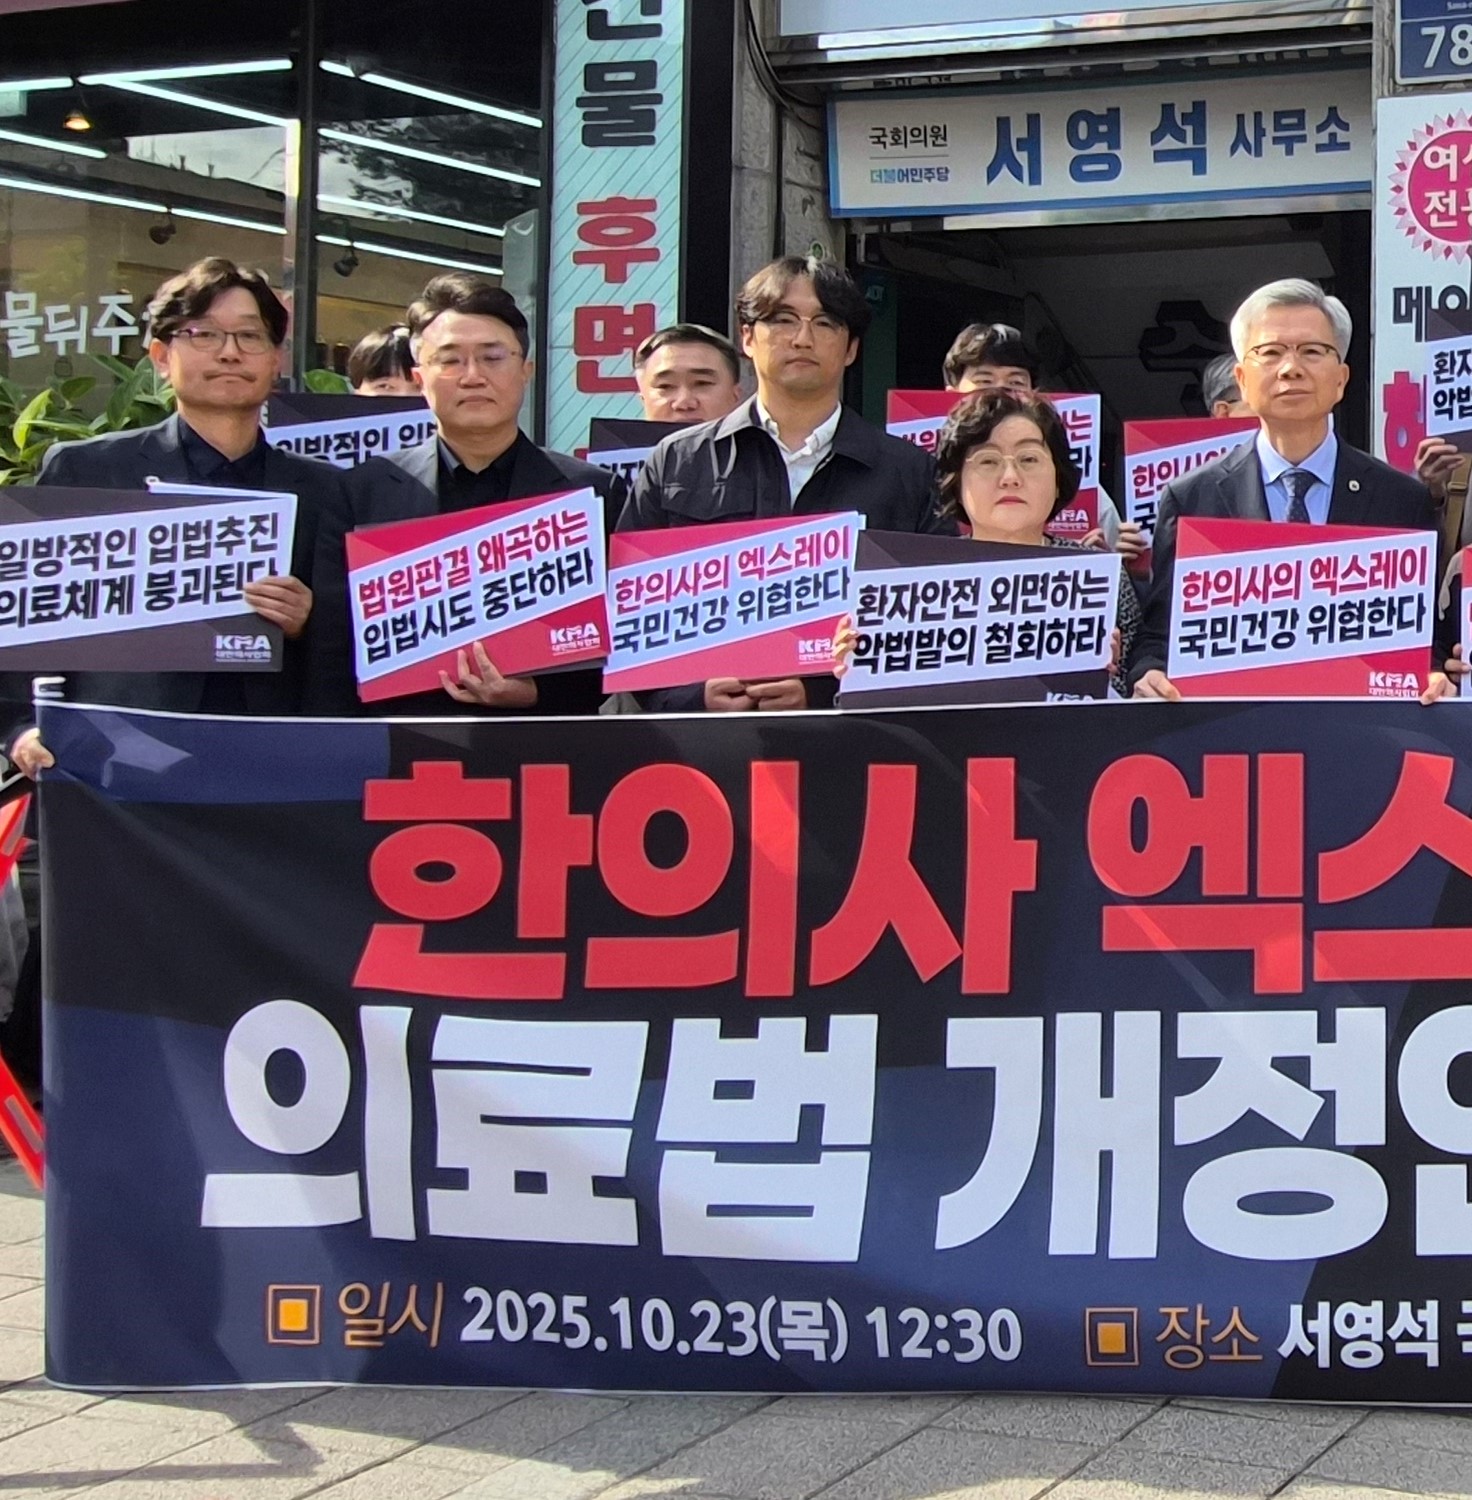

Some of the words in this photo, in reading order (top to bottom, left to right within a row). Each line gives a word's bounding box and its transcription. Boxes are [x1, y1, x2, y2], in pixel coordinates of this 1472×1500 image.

[868, 123, 949, 150] 국회의원
[986, 99, 1208, 187] 서영석
[1230, 104, 1351, 159] 사무소
[869, 165, 950, 185] 더불어민주당
[0, 290, 152, 359] 물뒤주
[573, 196, 661, 393] 후면
[0, 527, 137, 583] 일방적인
[148, 511, 279, 565] 입법추진
[358, 543, 471, 620] 법원판결
[477, 508, 589, 575] 왜곡하는
[615, 554, 730, 617] 한의사의
[737, 524, 850, 581] 엑스레이
[1182, 559, 1302, 613] 한의사의
[1309, 545, 1427, 596] 엑스레이
[0, 573, 136, 629] 의료체계
[361, 600, 477, 665] 입법시도
[482, 546, 593, 622] 중단하라
[550, 622, 600, 645] KMA
[613, 597, 728, 655] 국민건강
[737, 565, 851, 626] 위협한다
[856, 576, 982, 628] 환자안전
[987, 569, 1110, 616] 외면하는
[1178, 607, 1300, 660] 국민건강
[1306, 592, 1427, 645] 위협한다
[216, 634, 272, 650] KMA
[852, 624, 978, 675] 악법발의
[984, 614, 1107, 666] 철회하라
[1369, 671, 1419, 688] KMA
[352, 755, 1039, 1000] 한의사
[200, 998, 879, 1263] 의료법
[337, 1281, 445, 1349] 일시
[460, 1286, 850, 1363] 2025.10.23(목)
[865, 1304, 1024, 1363] 12:30
[1154, 1303, 1264, 1370] 장소
[1276, 1299, 1442, 1369] 서영석
